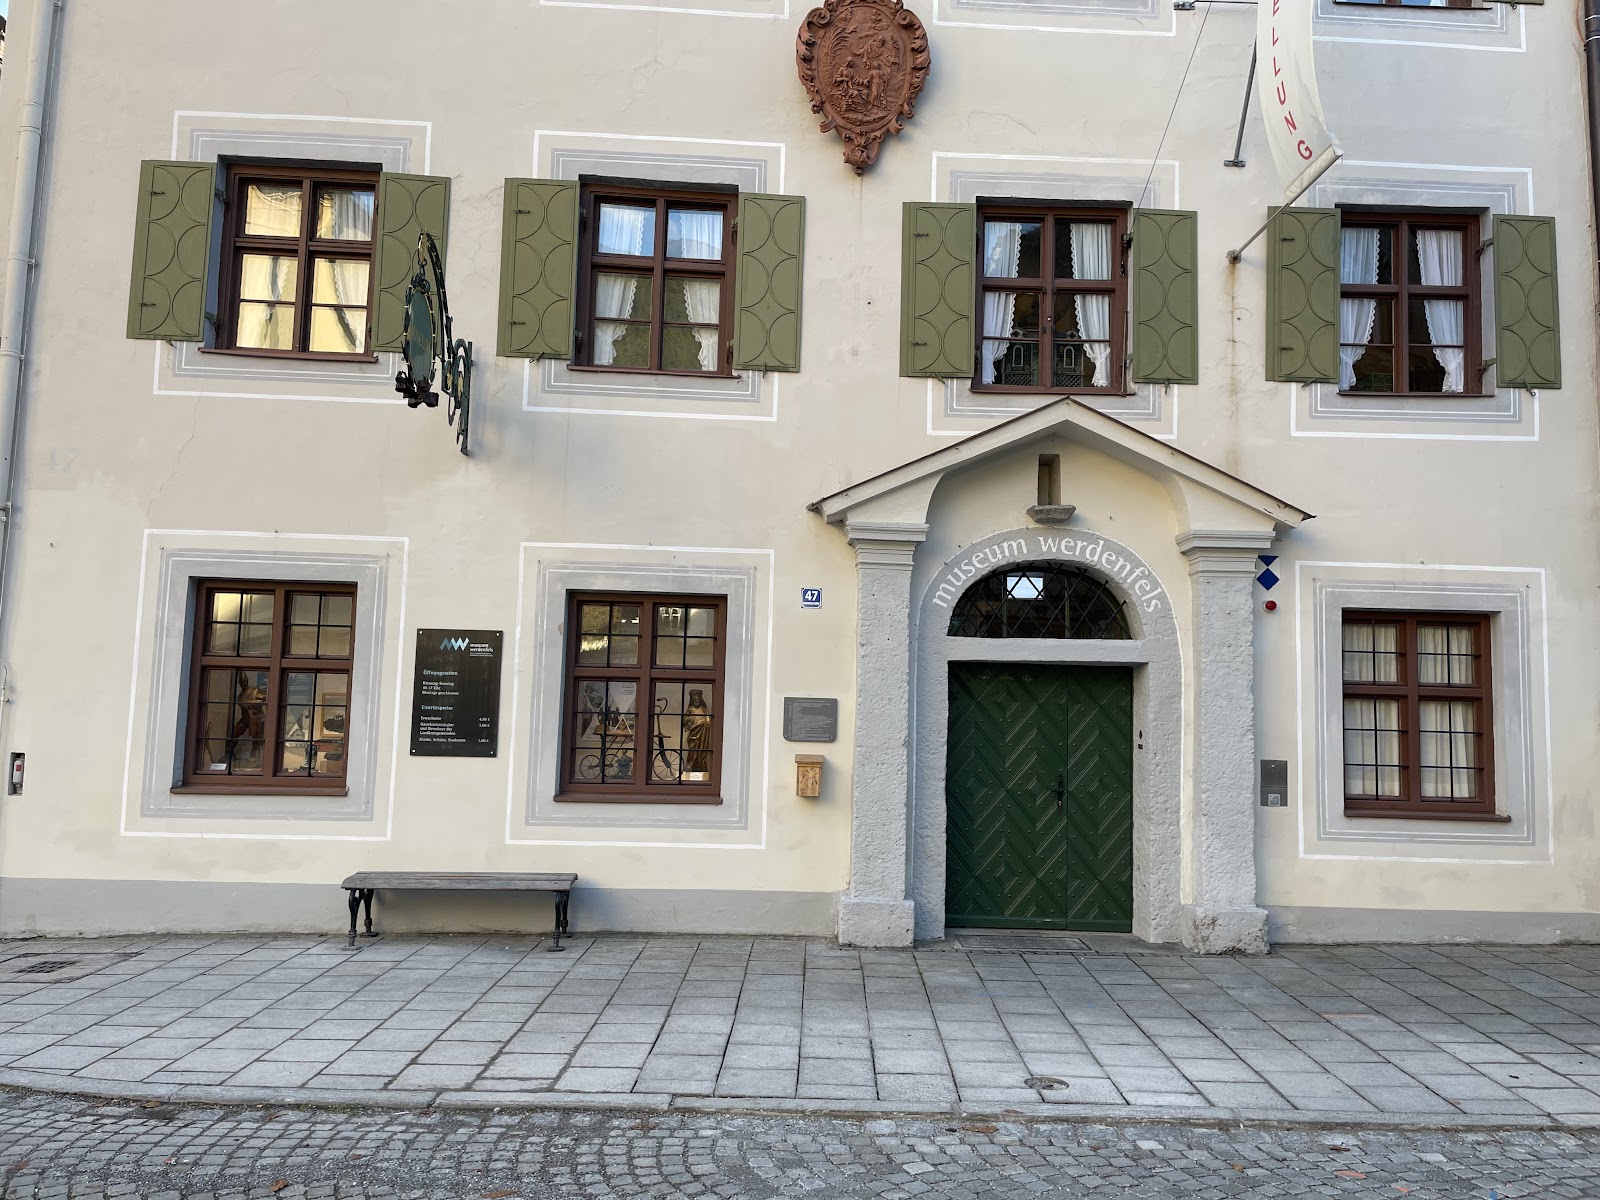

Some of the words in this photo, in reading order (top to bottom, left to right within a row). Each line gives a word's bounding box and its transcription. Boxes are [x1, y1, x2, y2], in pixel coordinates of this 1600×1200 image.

[804, 590, 819, 601] 47
[932, 537, 1028, 609] museum
[1037, 536, 1162, 613] werdenfels
